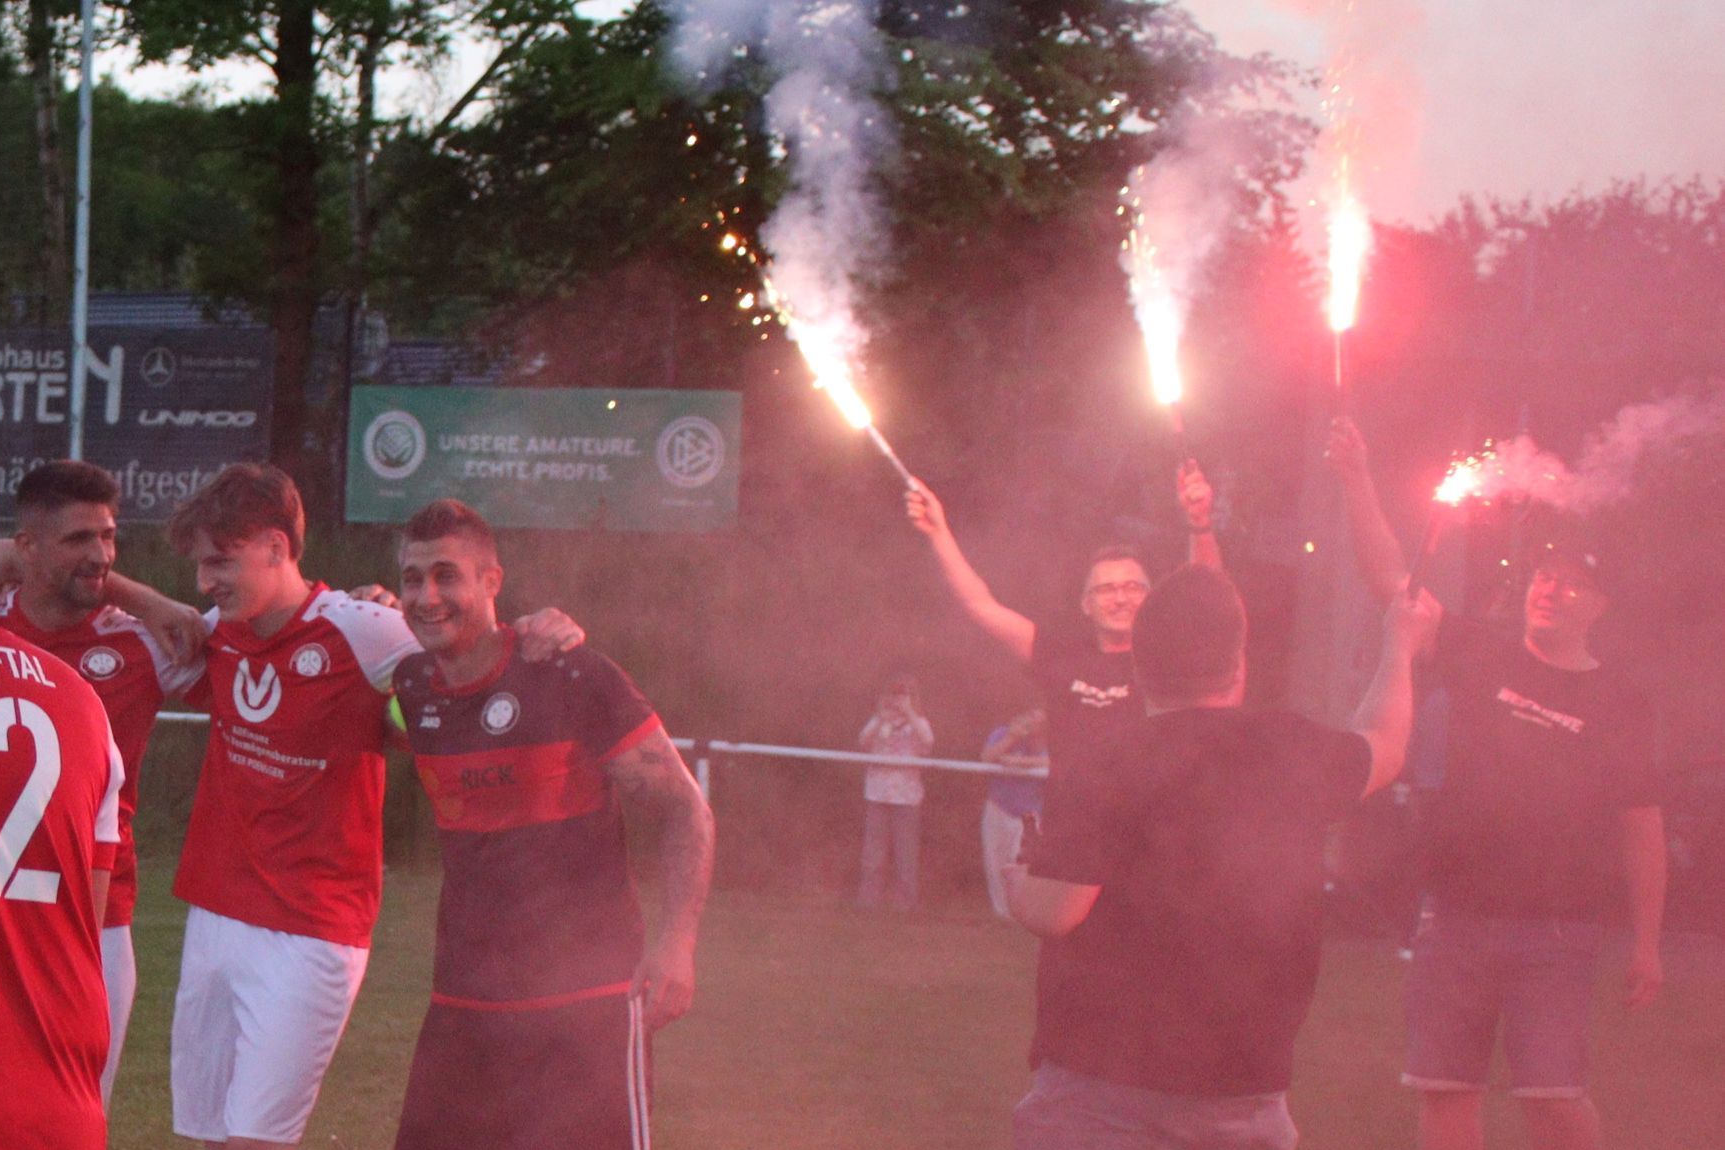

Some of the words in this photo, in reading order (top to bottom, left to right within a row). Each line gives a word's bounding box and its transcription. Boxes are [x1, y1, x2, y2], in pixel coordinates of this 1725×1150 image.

[137, 409, 257, 427] UNIMOG
[438, 434, 520, 454] UNSERE
[524, 436, 641, 457] AMATEURE.
[464, 460, 529, 479] ECHTE
